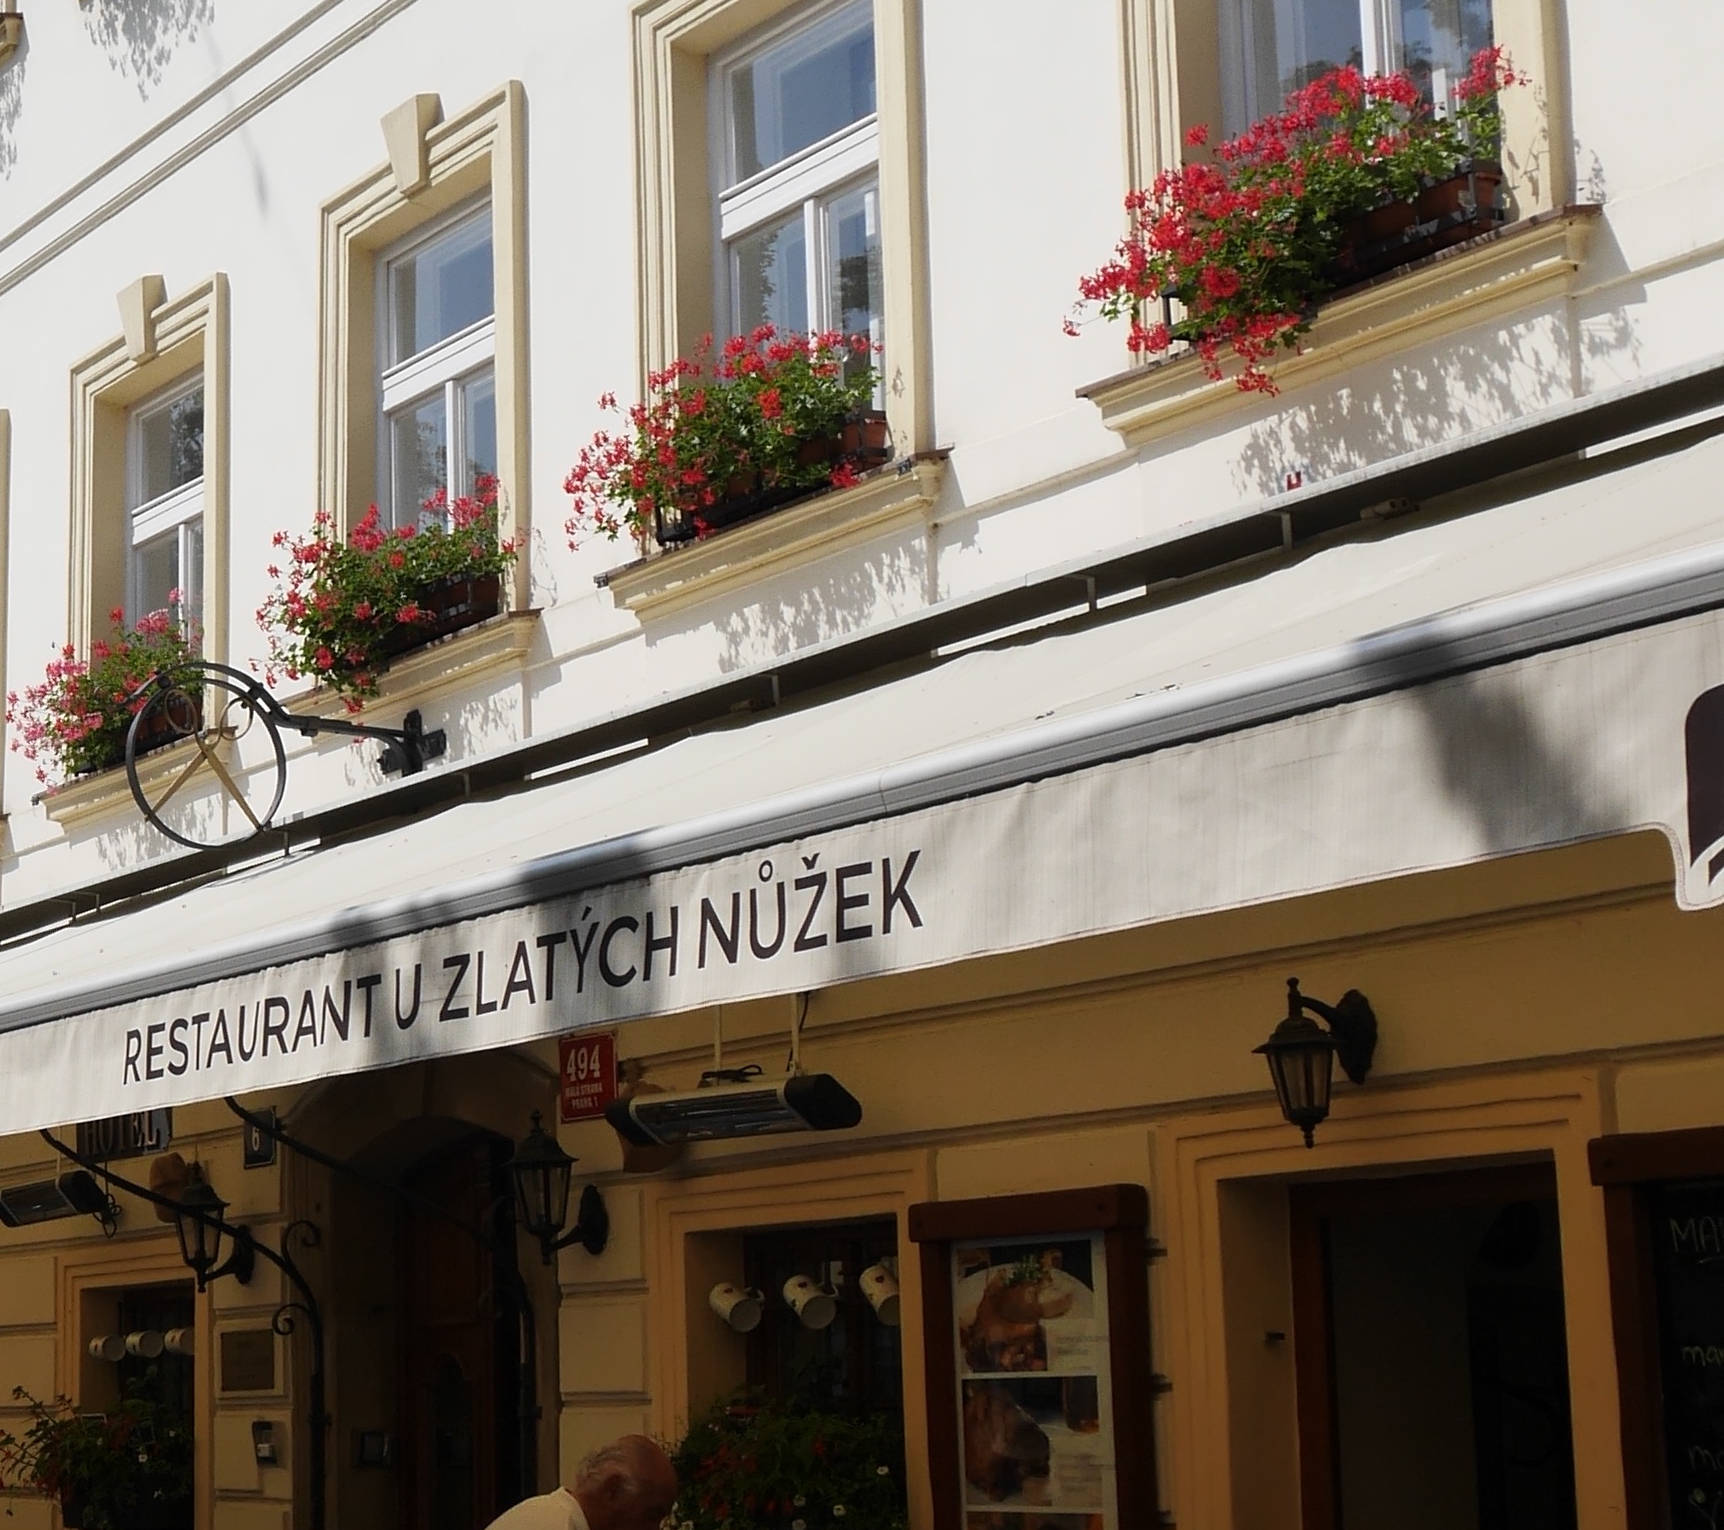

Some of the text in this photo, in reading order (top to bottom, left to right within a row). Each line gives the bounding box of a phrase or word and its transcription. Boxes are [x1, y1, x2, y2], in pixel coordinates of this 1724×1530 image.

[123, 849, 924, 1086] RESTAURANT U ZLATÝCH NŮŽEK
[566, 1041, 601, 1082] 494
[252, 1125, 261, 1152] 6
